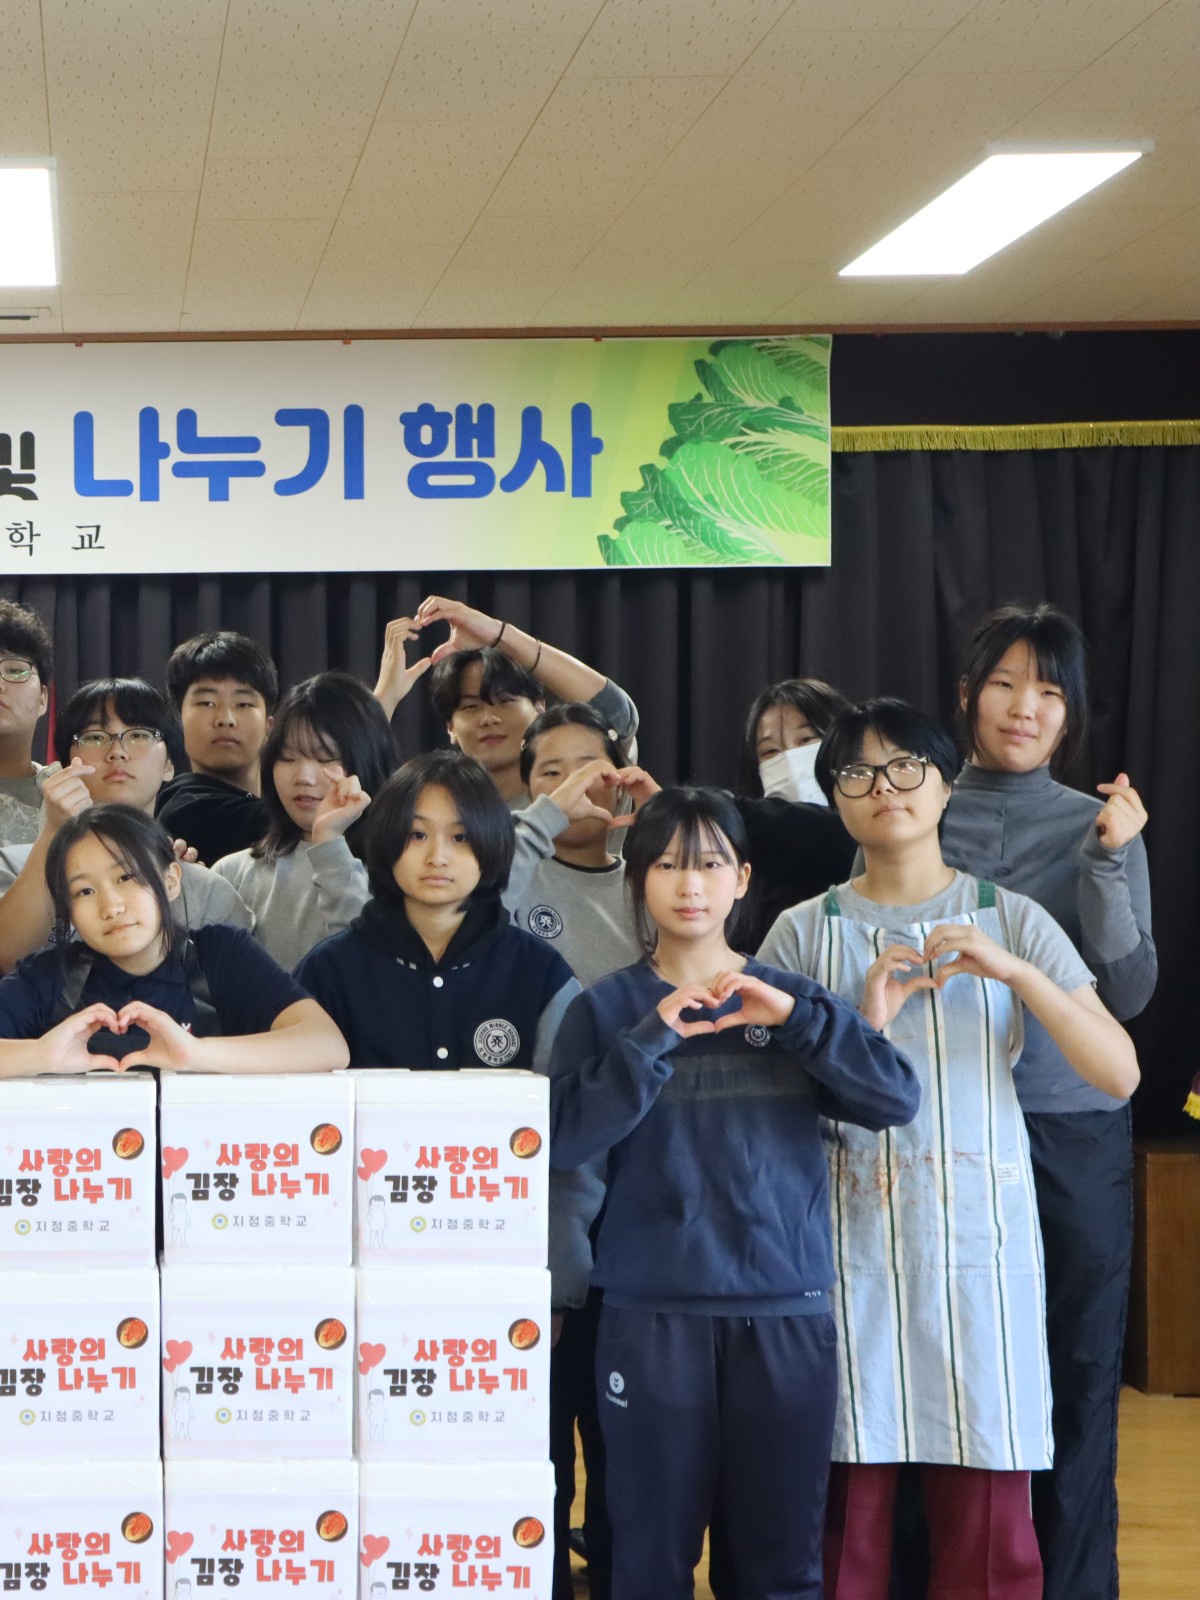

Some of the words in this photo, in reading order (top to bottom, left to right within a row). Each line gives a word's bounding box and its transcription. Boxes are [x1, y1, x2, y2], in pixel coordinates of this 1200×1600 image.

[74, 405, 364, 501] 나누기
[400, 404, 603, 498] 행사
[18, 1147, 101, 1175] 사랑의
[216, 1143, 299, 1171] 사랑의
[415, 1145, 498, 1173] 사랑의
[54, 1176, 131, 1205] 나누기
[186, 1174, 238, 1200] 김장
[252, 1170, 328, 1199] 나누기
[385, 1176, 437, 1202] 김장
[451, 1174, 528, 1203] 나누기
[35, 1219, 110, 1233] 지정중학교
[232, 1215, 308, 1228] 지정중학교
[430, 1218, 506, 1231] 지정중학교
[23, 1337, 106, 1365] 사랑의
[221, 1337, 304, 1365] 사랑의
[414, 1339, 497, 1367] 사랑의
[59, 1364, 135, 1393] 나누기
[190, 1367, 242, 1394] 김장
[256, 1365, 332, 1394] 나누기
[384, 1370, 436, 1396] 김장
[450, 1366, 526, 1395] 나누기
[39, 1409, 115, 1423] 지정중학교
[236, 1409, 311, 1422] 지정중학교
[430, 1410, 505, 1424] 지정중학교
[28, 1532, 111, 1560] 사랑의
[221, 1529, 304, 1557] 사랑의
[417, 1533, 500, 1561] 사랑의
[64, 1559, 140, 1588] 나누기
[192, 1559, 243, 1585] 김장
[257, 1556, 334, 1585] 나누기
[387, 1563, 439, 1590] 김장
[453, 1562, 530, 1591] 나누기
